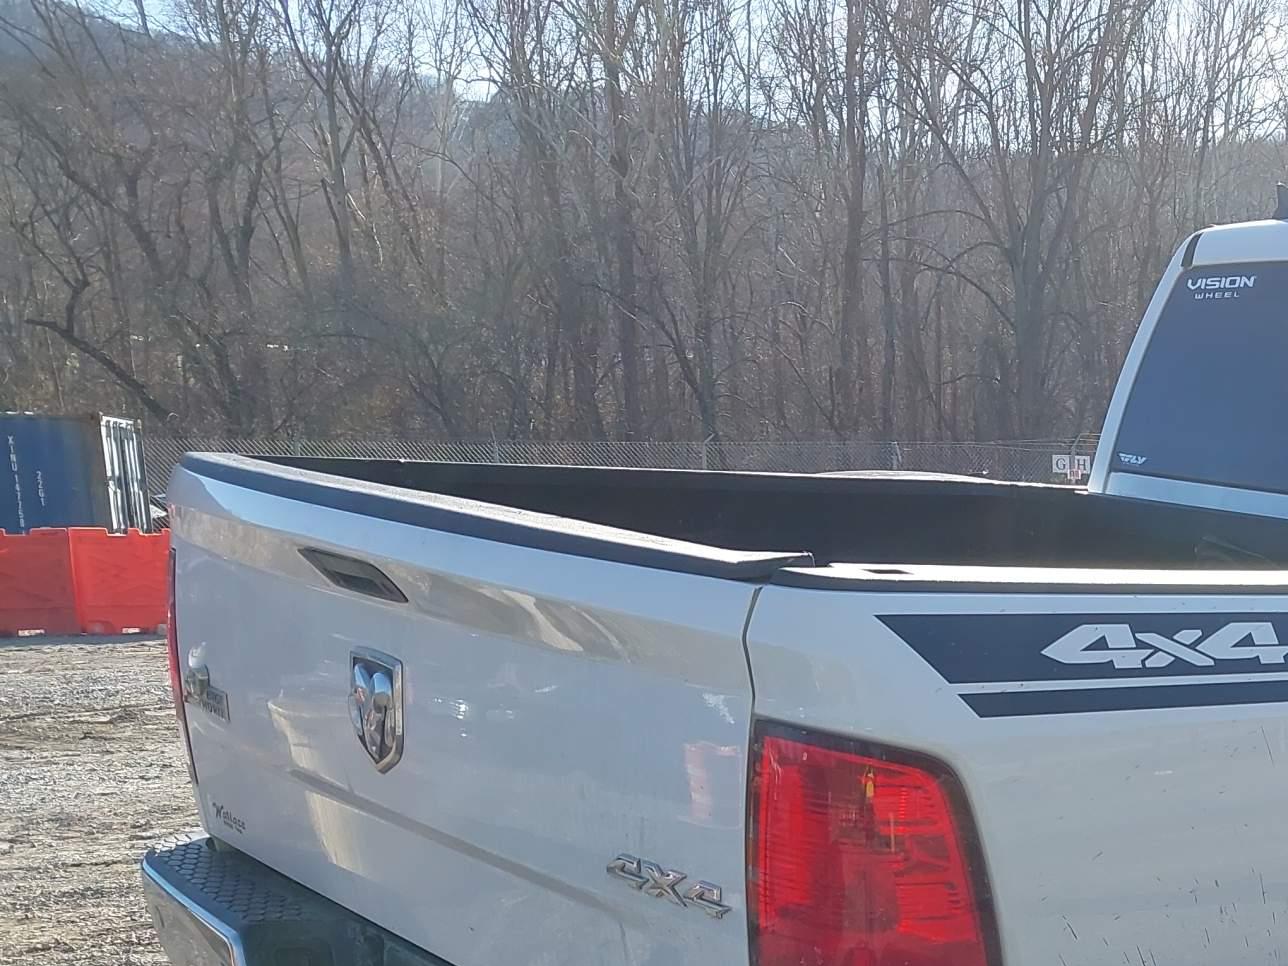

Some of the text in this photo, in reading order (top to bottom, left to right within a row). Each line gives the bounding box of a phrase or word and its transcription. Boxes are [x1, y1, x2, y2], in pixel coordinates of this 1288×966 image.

[1187, 276, 1255, 290] VISION
[1194, 291, 1240, 299] WHEEL
[1055, 457, 1066, 471] G
[1076, 459, 1088, 473] H
